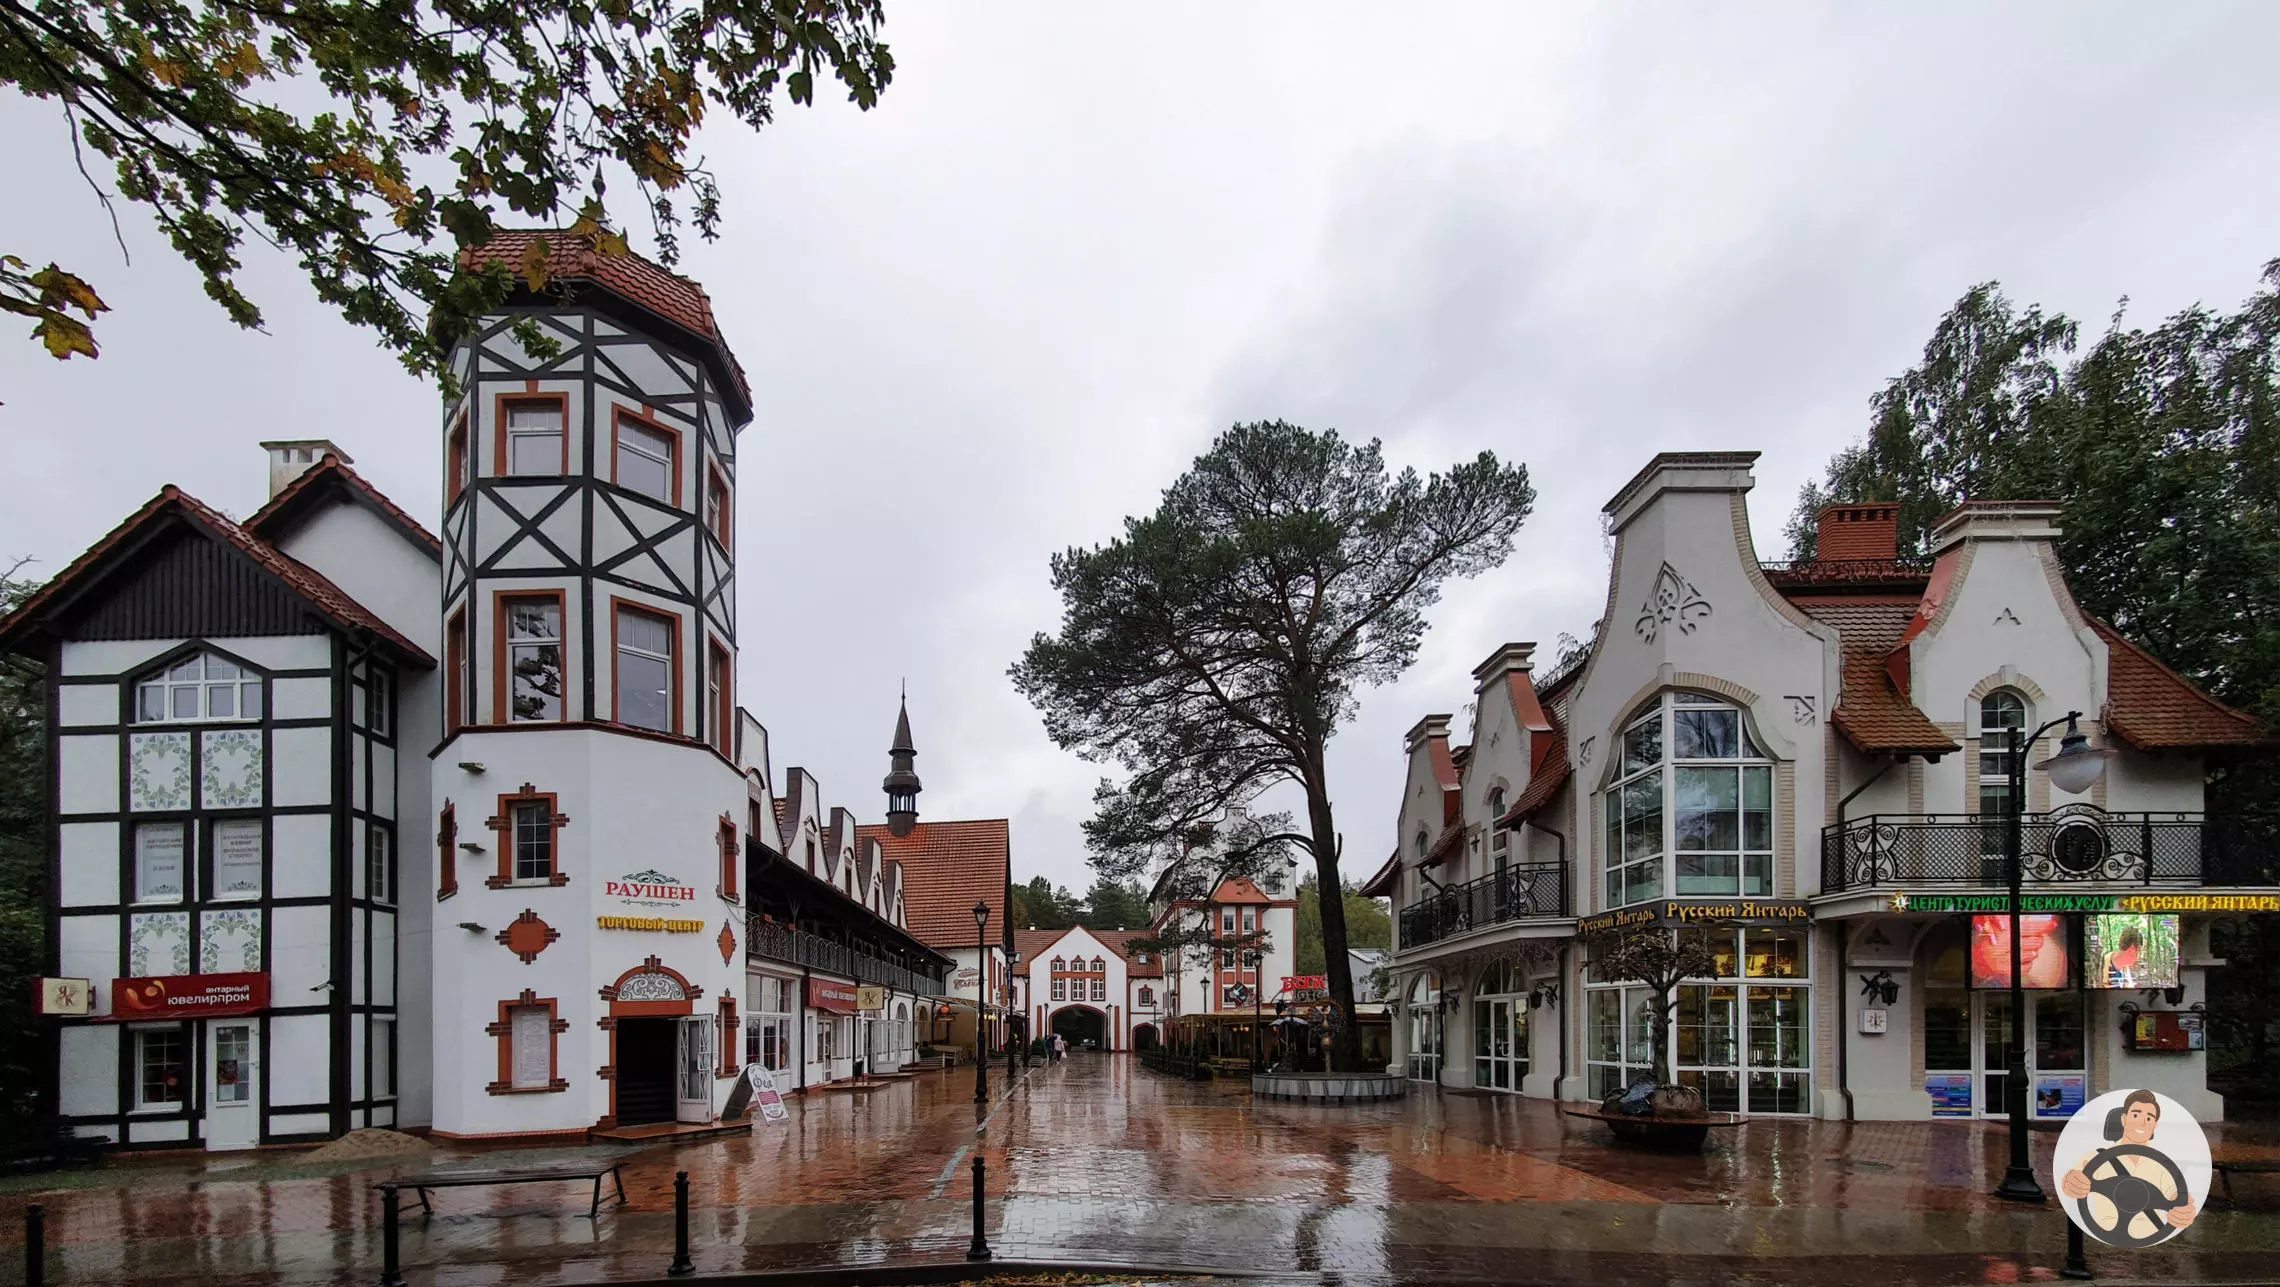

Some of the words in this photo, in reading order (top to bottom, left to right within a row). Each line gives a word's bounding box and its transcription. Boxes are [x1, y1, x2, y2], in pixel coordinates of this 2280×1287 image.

[605, 881, 695, 900] РАУШЕН
[1667, 902, 1736, 922] Русский
[1740, 902, 1808, 920] Янтарь
[1908, 896, 1953, 912] ЦЕНТР
[1955, 896, 2073, 911] ТУРИСТЧЕСКИХ
[2075, 896, 2118, 911] УСЛУГ
[597, 916, 664, 931] ТОРГОВЫЙ
[666, 919, 705, 933] ЦЕНТР
[1578, 913, 1614, 936] Русский
[1616, 908, 1655, 925] Янтарь
[206, 984, 250, 994] янтарный
[167, 992, 250, 1005] ювелирпром
